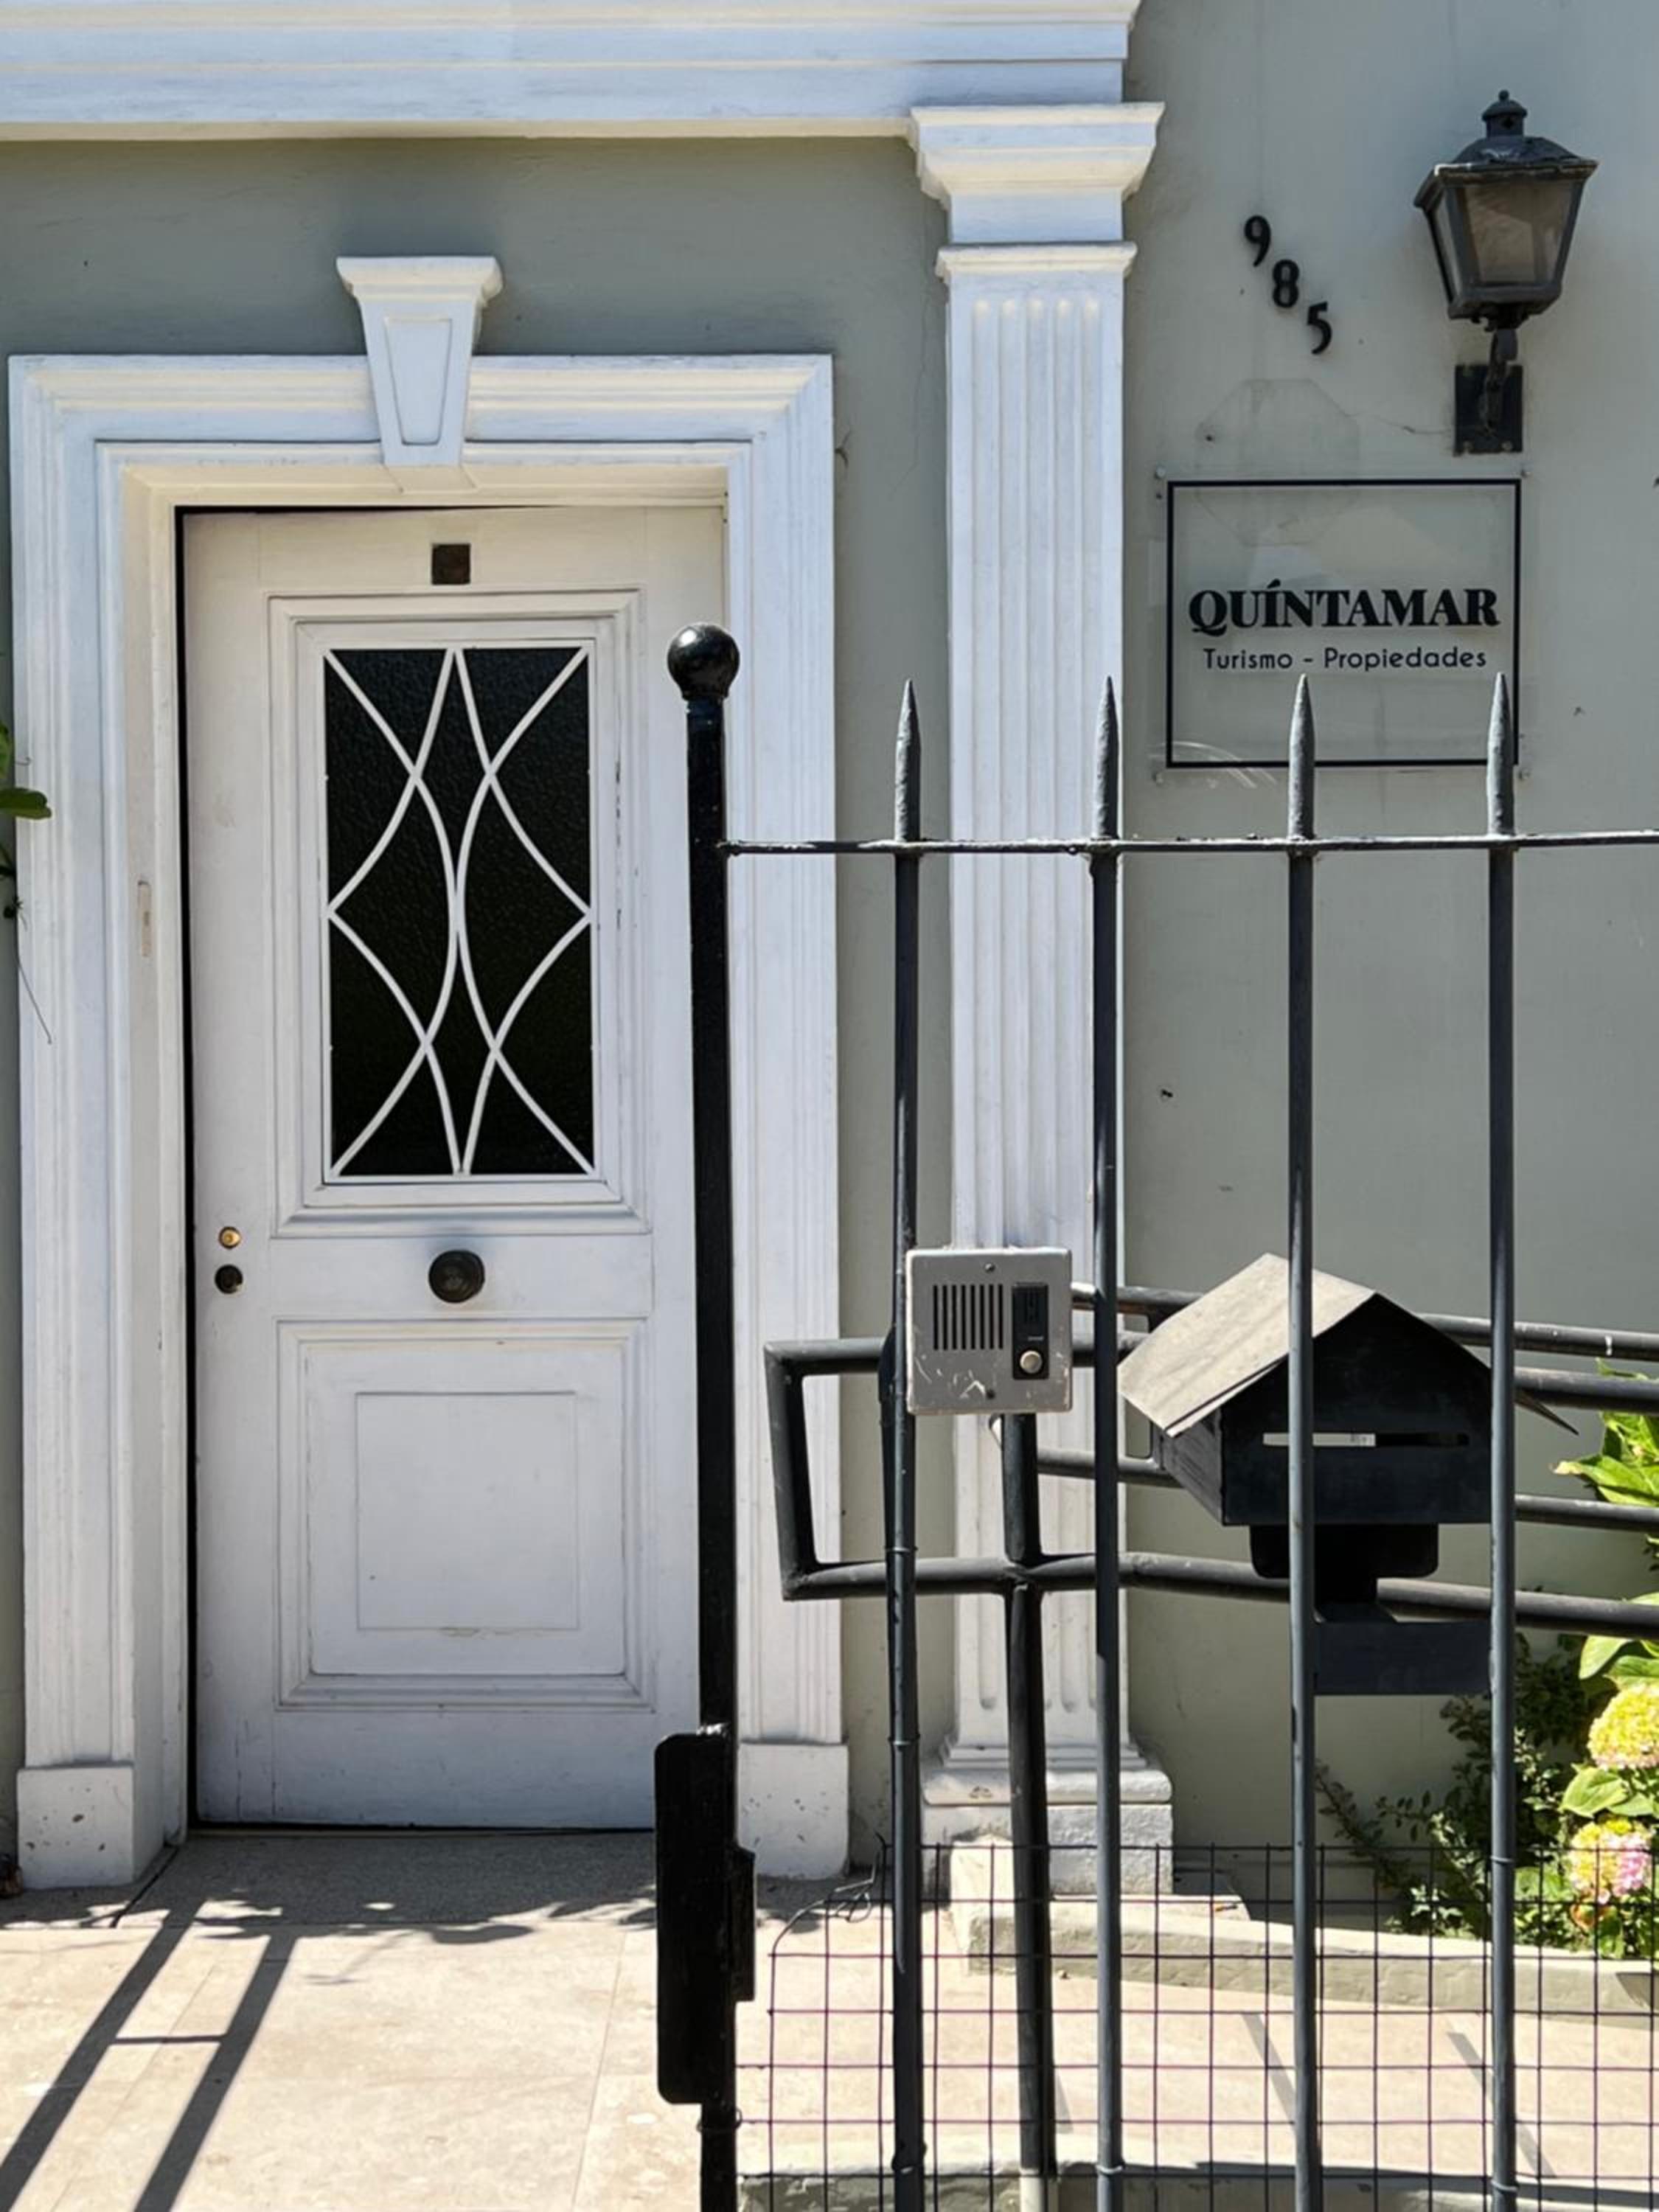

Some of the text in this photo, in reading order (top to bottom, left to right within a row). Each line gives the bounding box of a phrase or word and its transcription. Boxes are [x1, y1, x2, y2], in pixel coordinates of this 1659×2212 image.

[1244, 215, 1332, 355] 985
[1188, 578, 1501, 637] QUÍNTAMAR
[1203, 648, 1293, 669] Turismo
[1324, 647, 1487, 672] Propiedades
